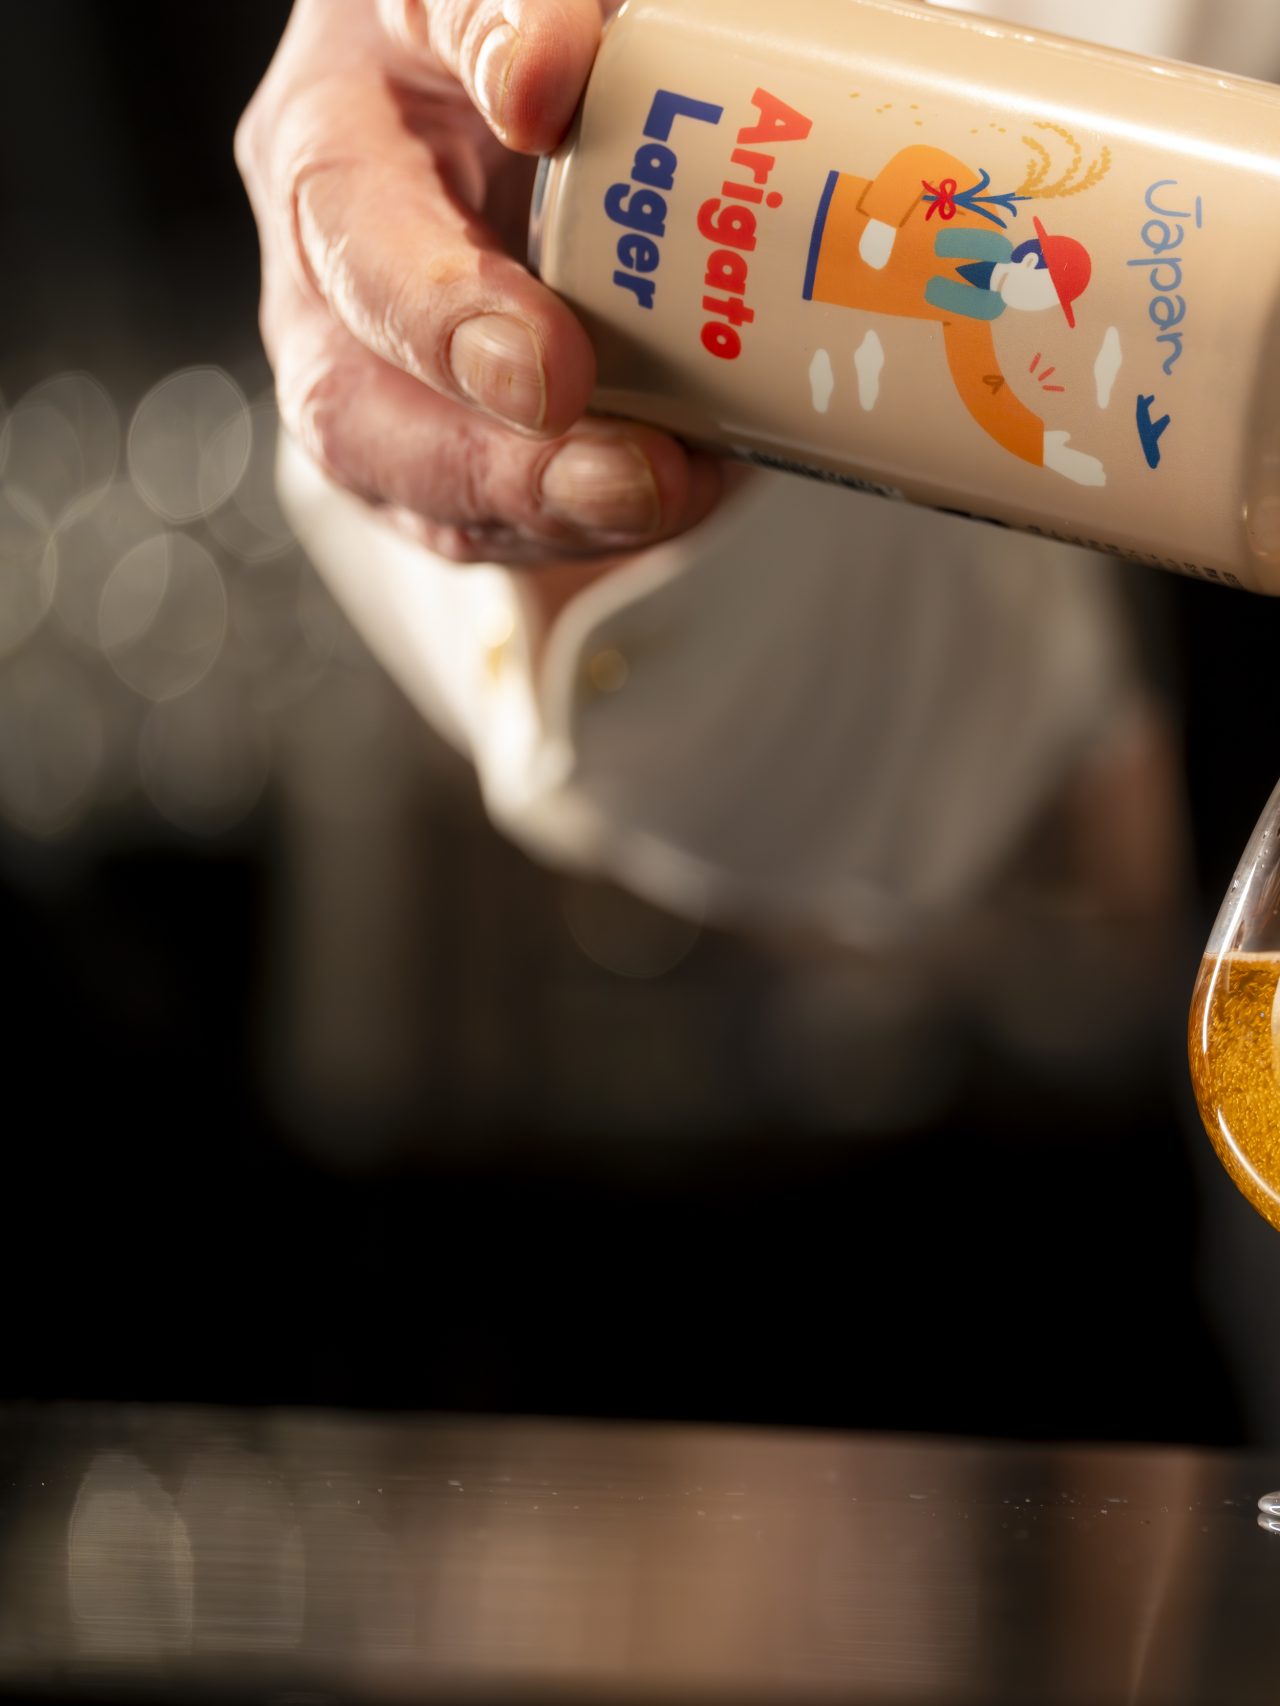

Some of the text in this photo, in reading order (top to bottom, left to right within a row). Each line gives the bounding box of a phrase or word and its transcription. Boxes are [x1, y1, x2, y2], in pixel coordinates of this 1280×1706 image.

[603, 89, 724, 310] Lager
[697, 87, 813, 361] Arigato
[1126, 180, 1203, 376] Japan
